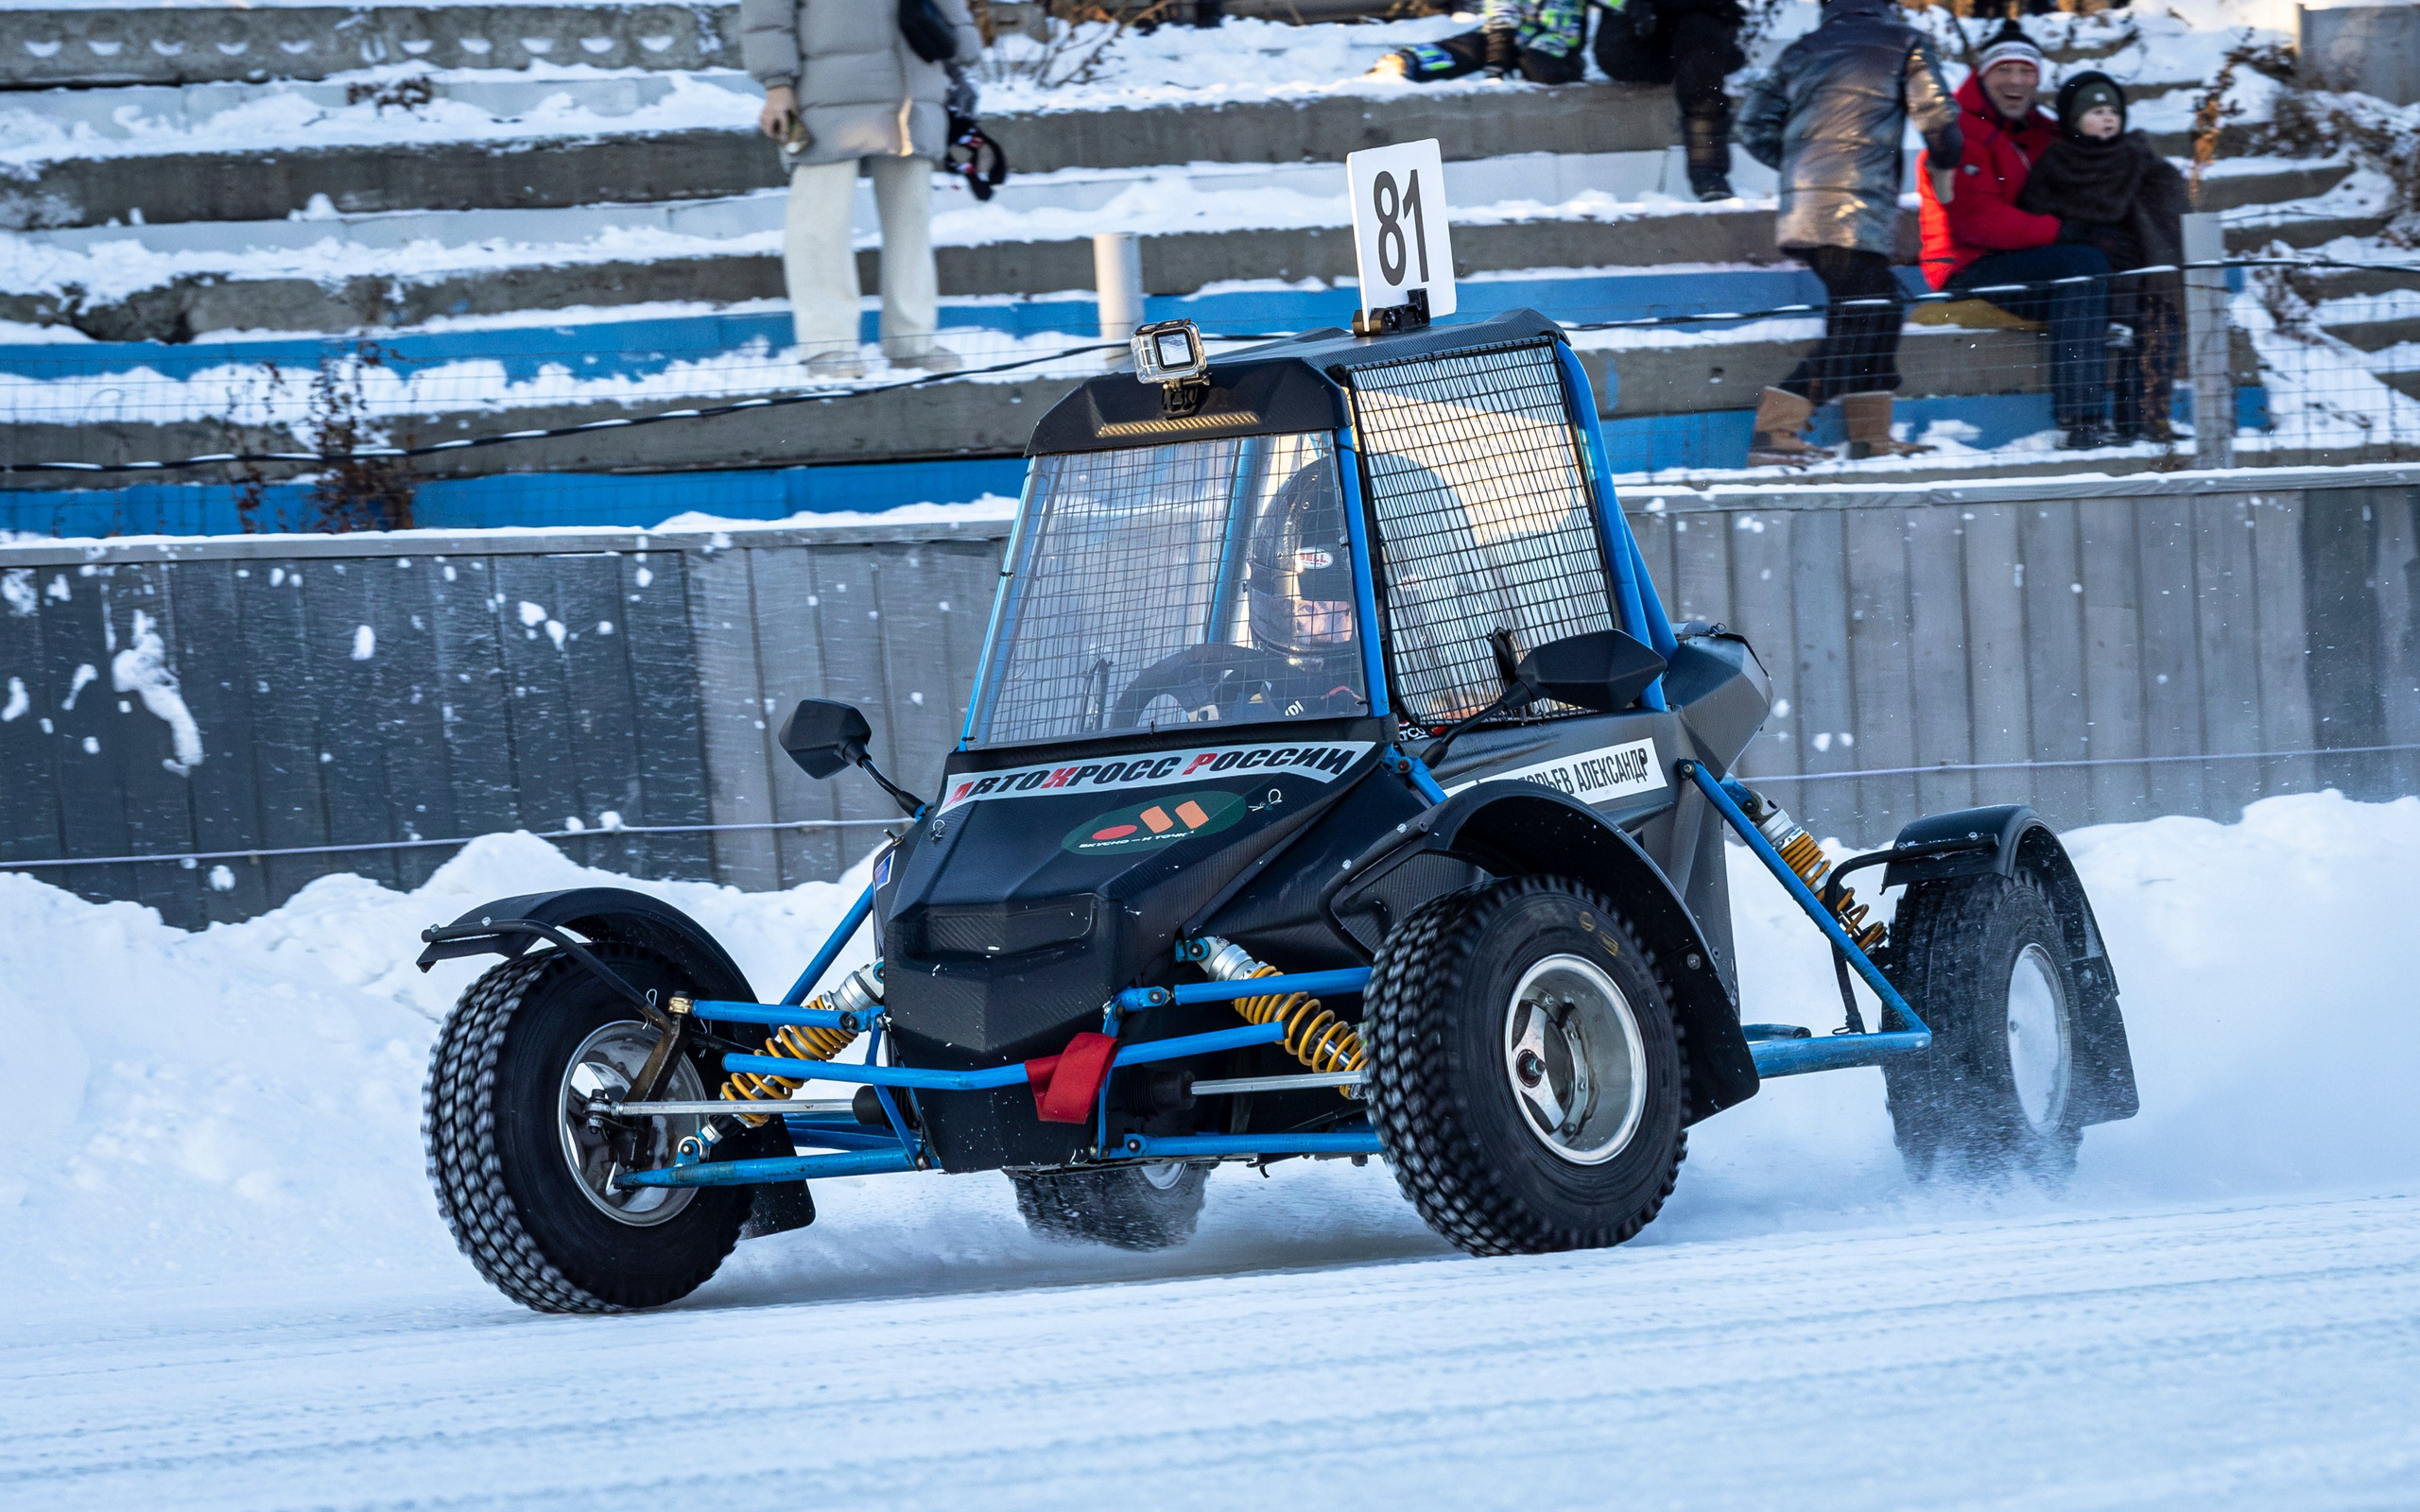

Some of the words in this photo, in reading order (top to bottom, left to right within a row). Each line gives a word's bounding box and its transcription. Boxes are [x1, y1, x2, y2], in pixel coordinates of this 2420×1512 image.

[1374, 169, 1429, 285] 81
[944, 757, 1182, 808] АВТОКРОСС
[1182, 747, 1357, 776] РОССИИ
[1573, 747, 1649, 792] АЛЕКСАНДР
